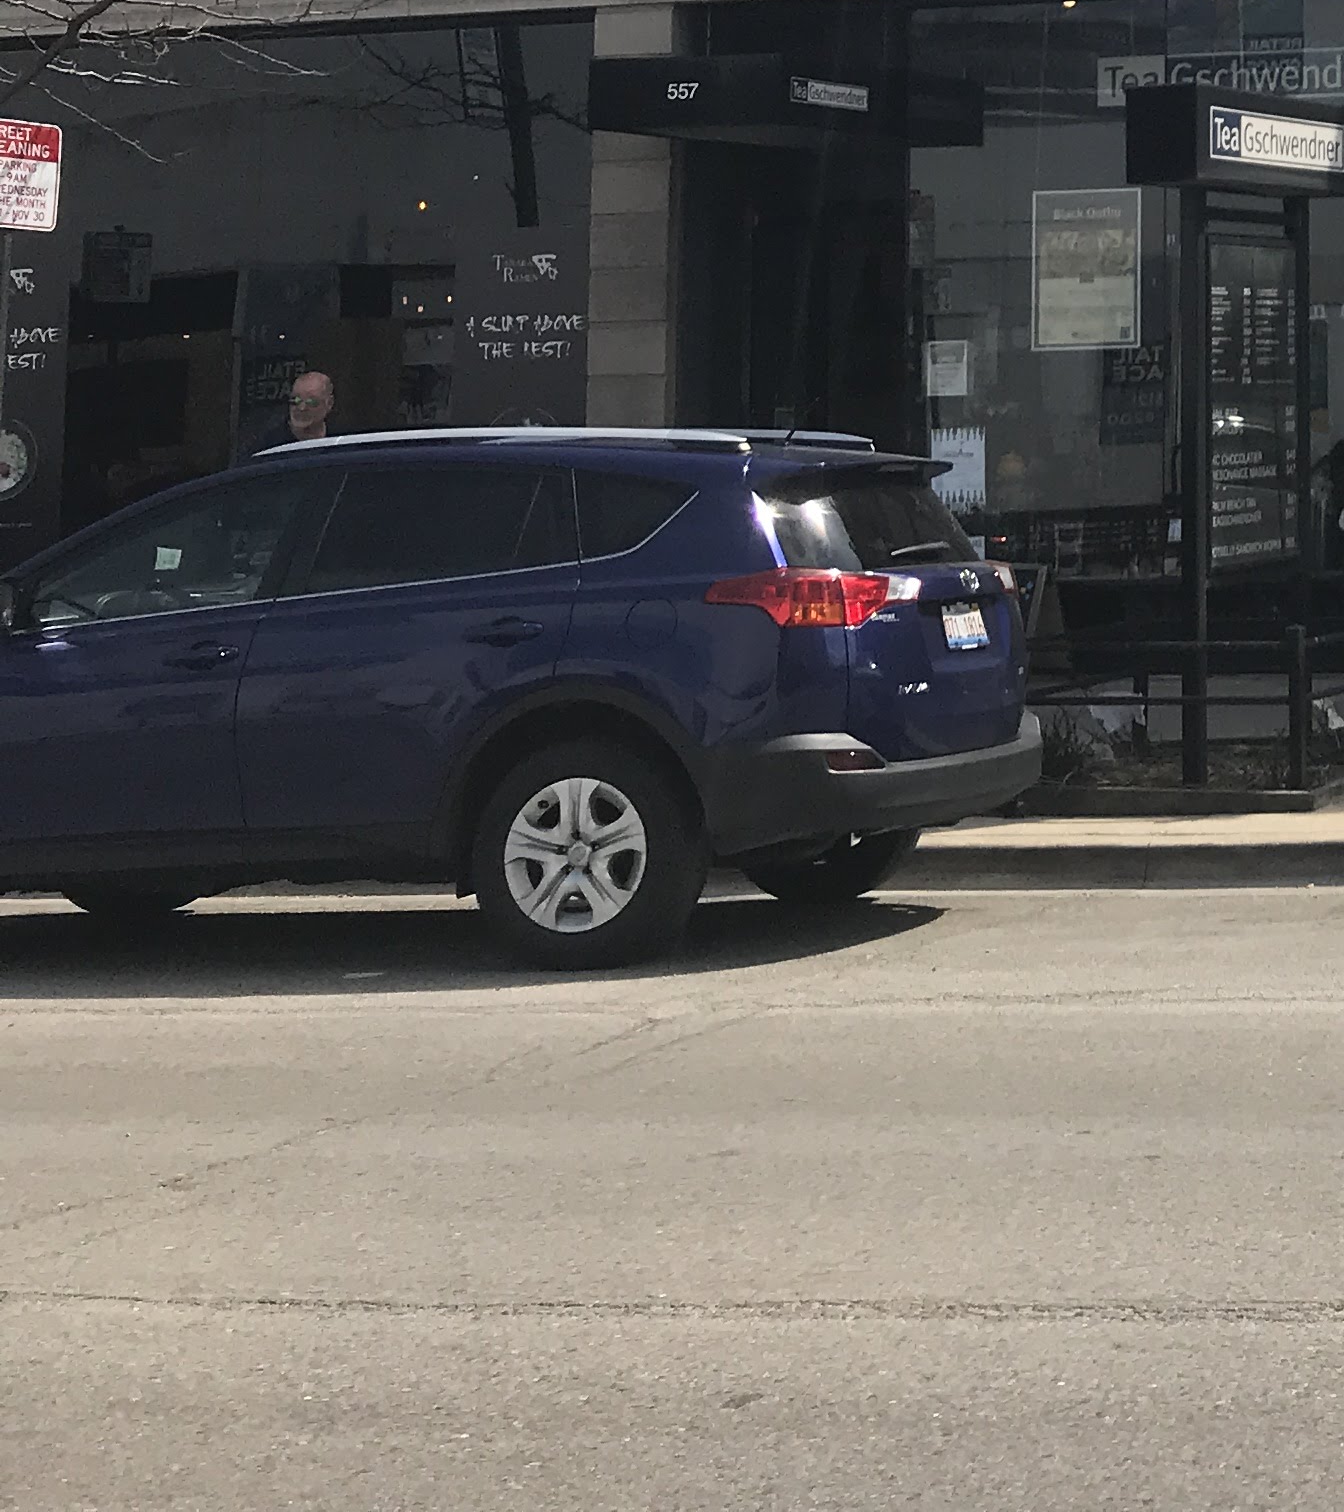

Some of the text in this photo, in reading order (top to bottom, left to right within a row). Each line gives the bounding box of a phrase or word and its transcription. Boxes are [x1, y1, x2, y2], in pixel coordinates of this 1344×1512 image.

[667, 83, 699, 99] 557
[1214, 116, 1341, 163] Tea Gschwendner
[16, 196, 46, 209] MONTH
[478, 341, 515, 361] THE
